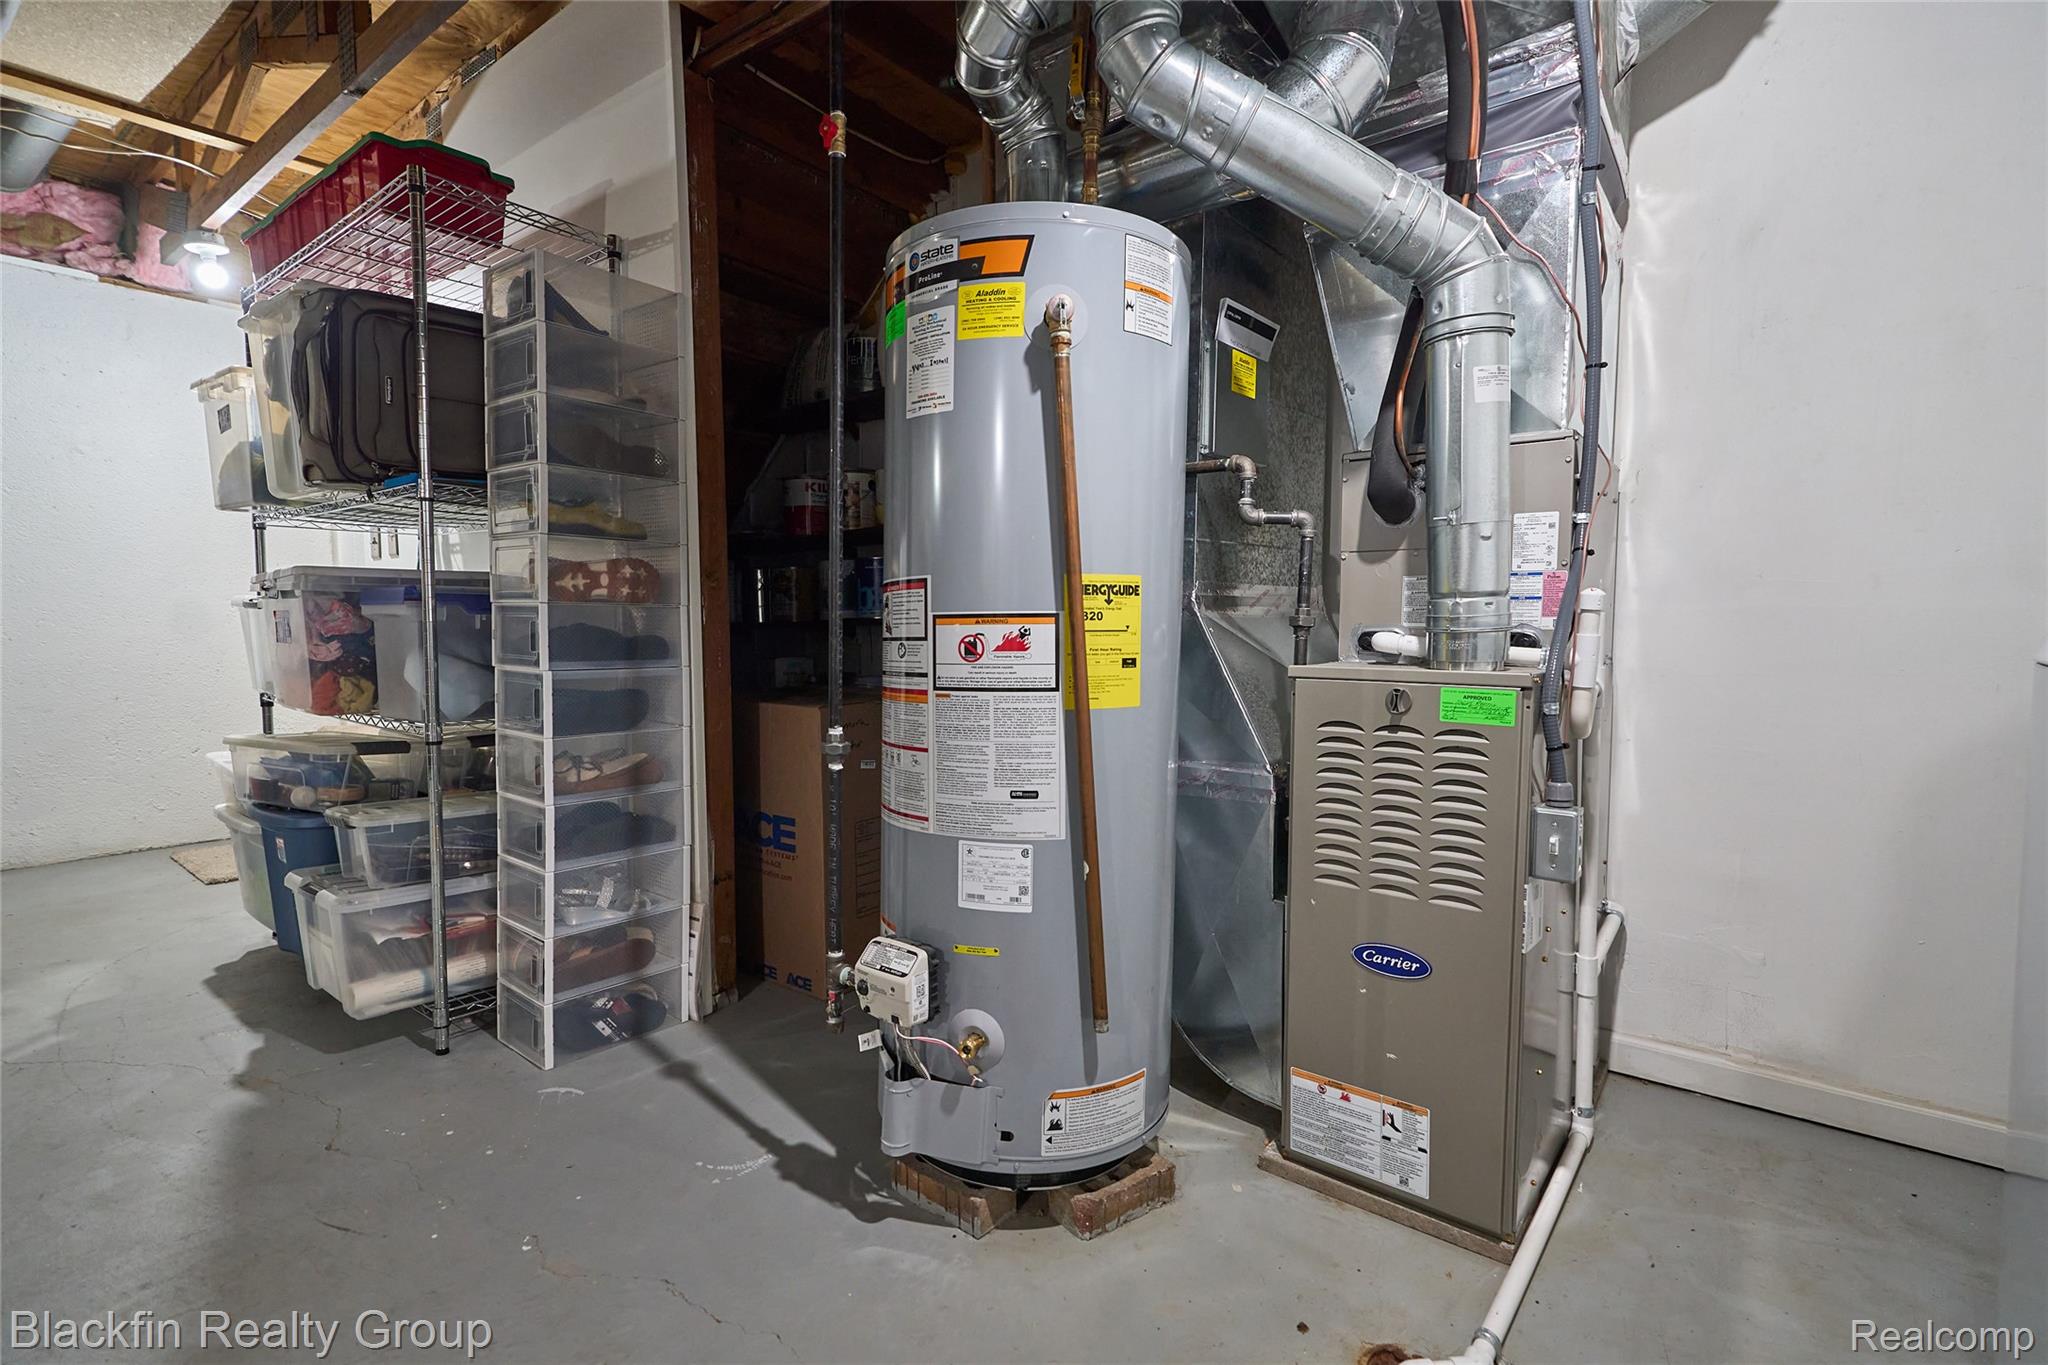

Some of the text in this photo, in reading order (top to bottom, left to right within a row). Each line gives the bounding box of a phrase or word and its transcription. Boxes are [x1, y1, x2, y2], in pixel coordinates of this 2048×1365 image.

[920, 244, 954, 262] state
[975, 288, 1006, 298] Aladdin
[804, 482, 829, 493] KIL
[1362, 949, 1420, 972] Carrier
